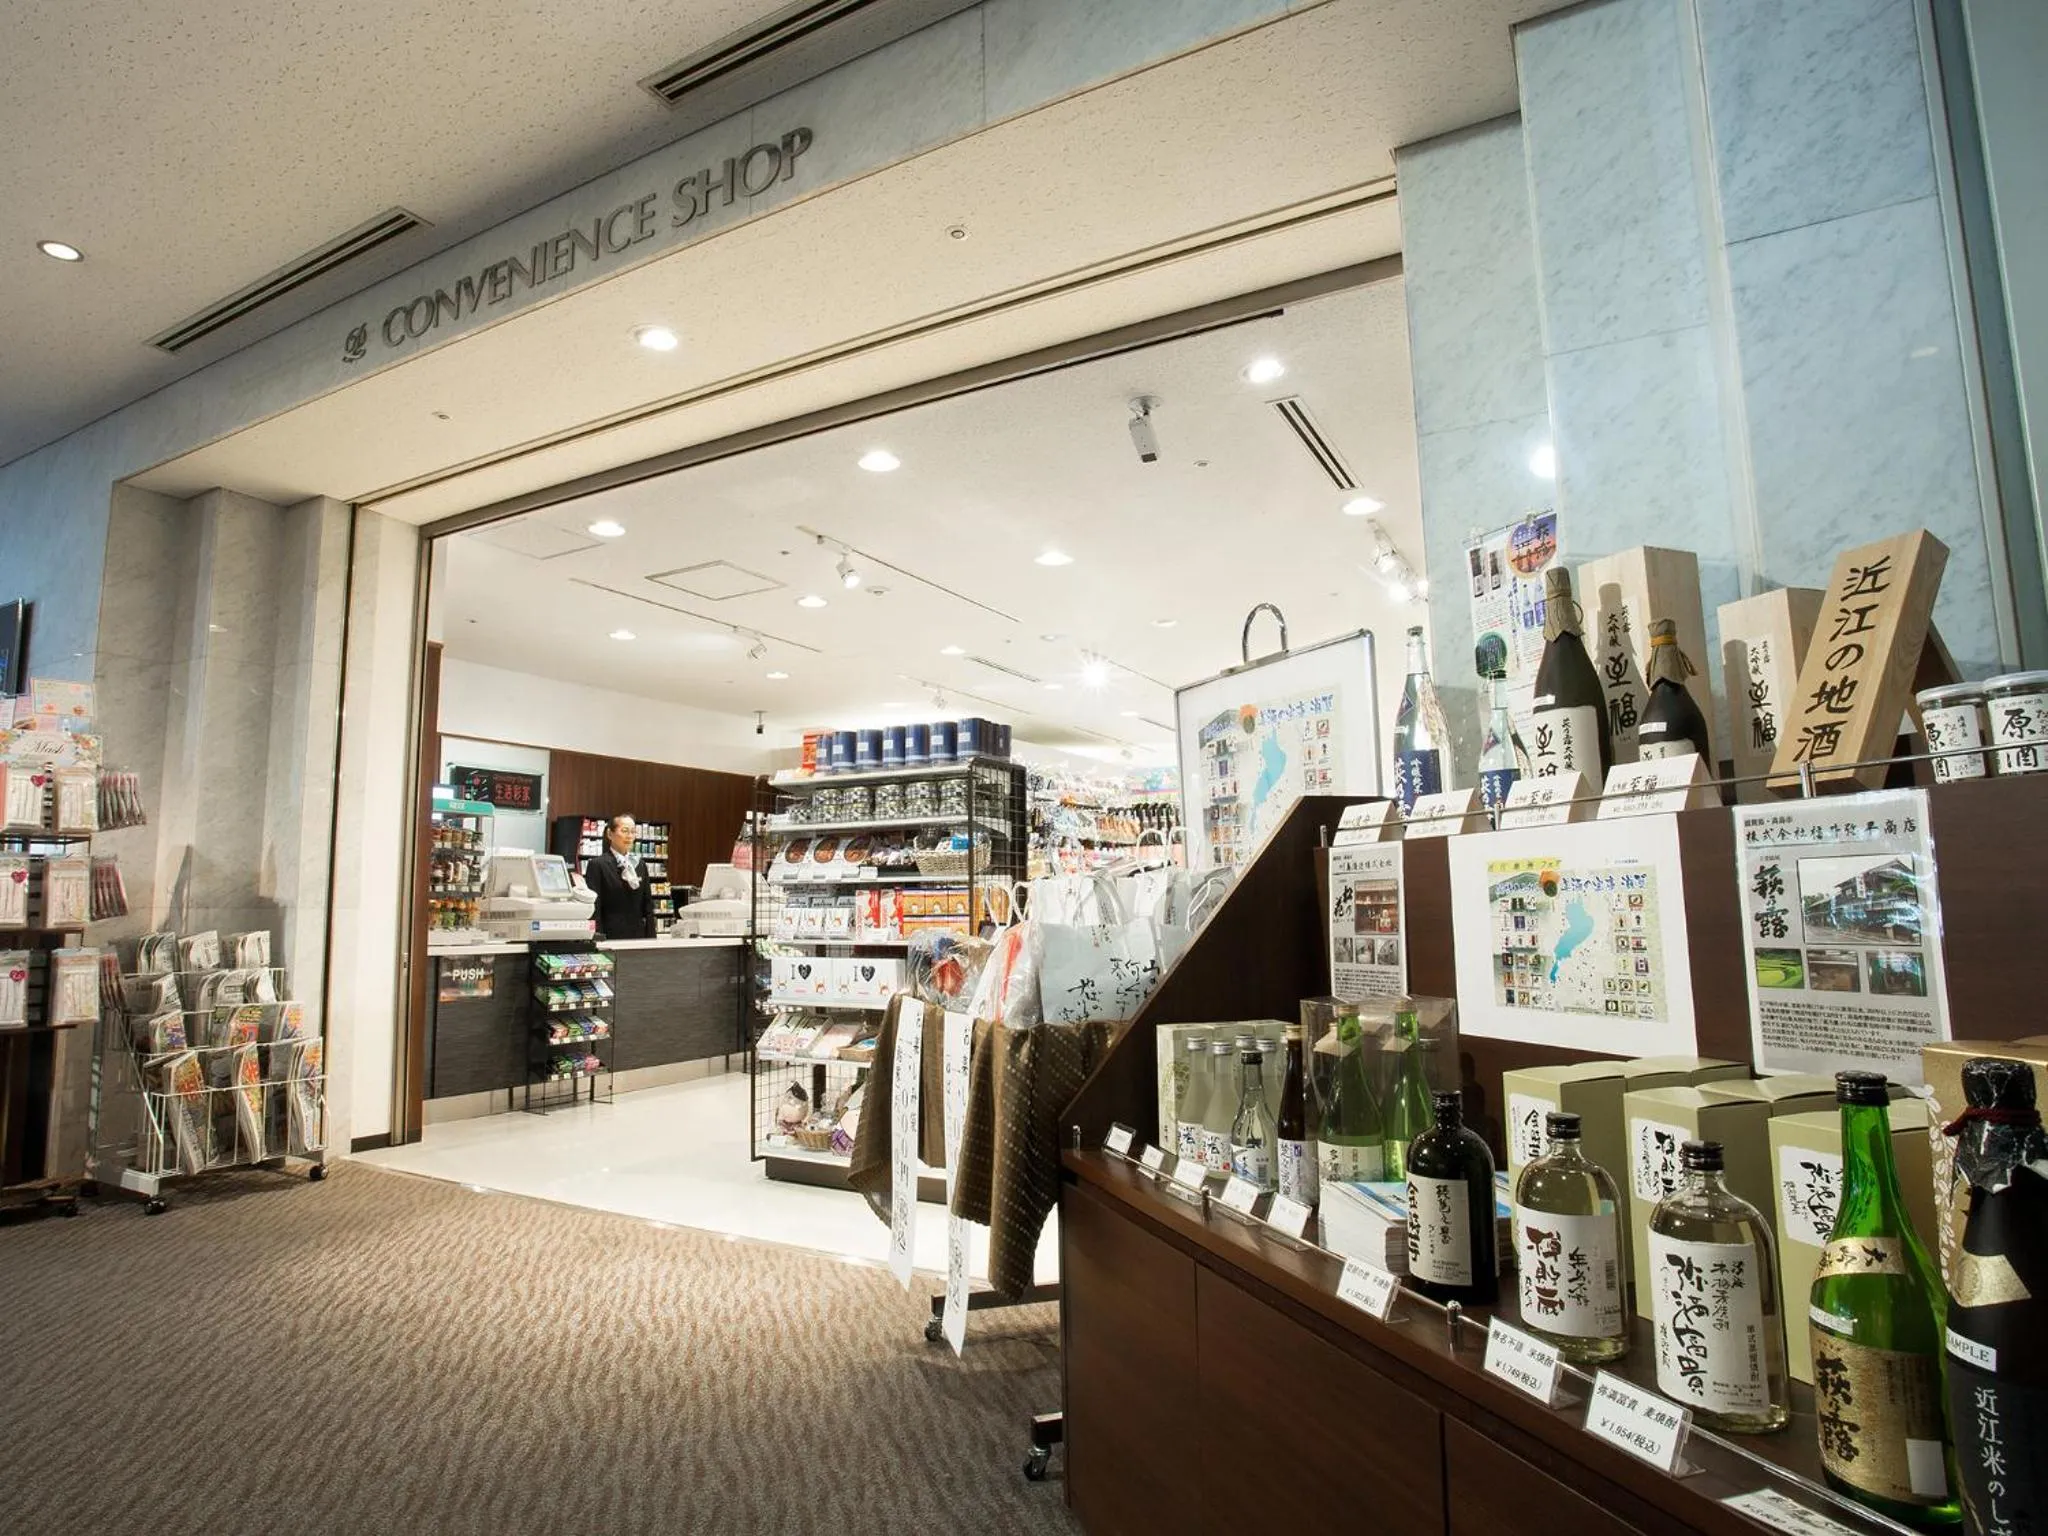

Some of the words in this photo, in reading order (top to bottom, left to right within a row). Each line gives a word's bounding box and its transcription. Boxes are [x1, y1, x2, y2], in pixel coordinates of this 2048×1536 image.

[381, 192, 658, 348] CONVENIENCE
[670, 125, 814, 229] SHOP
[1792, 555, 1893, 763] 近江の地酒
[452, 967, 485, 981] PUSH
